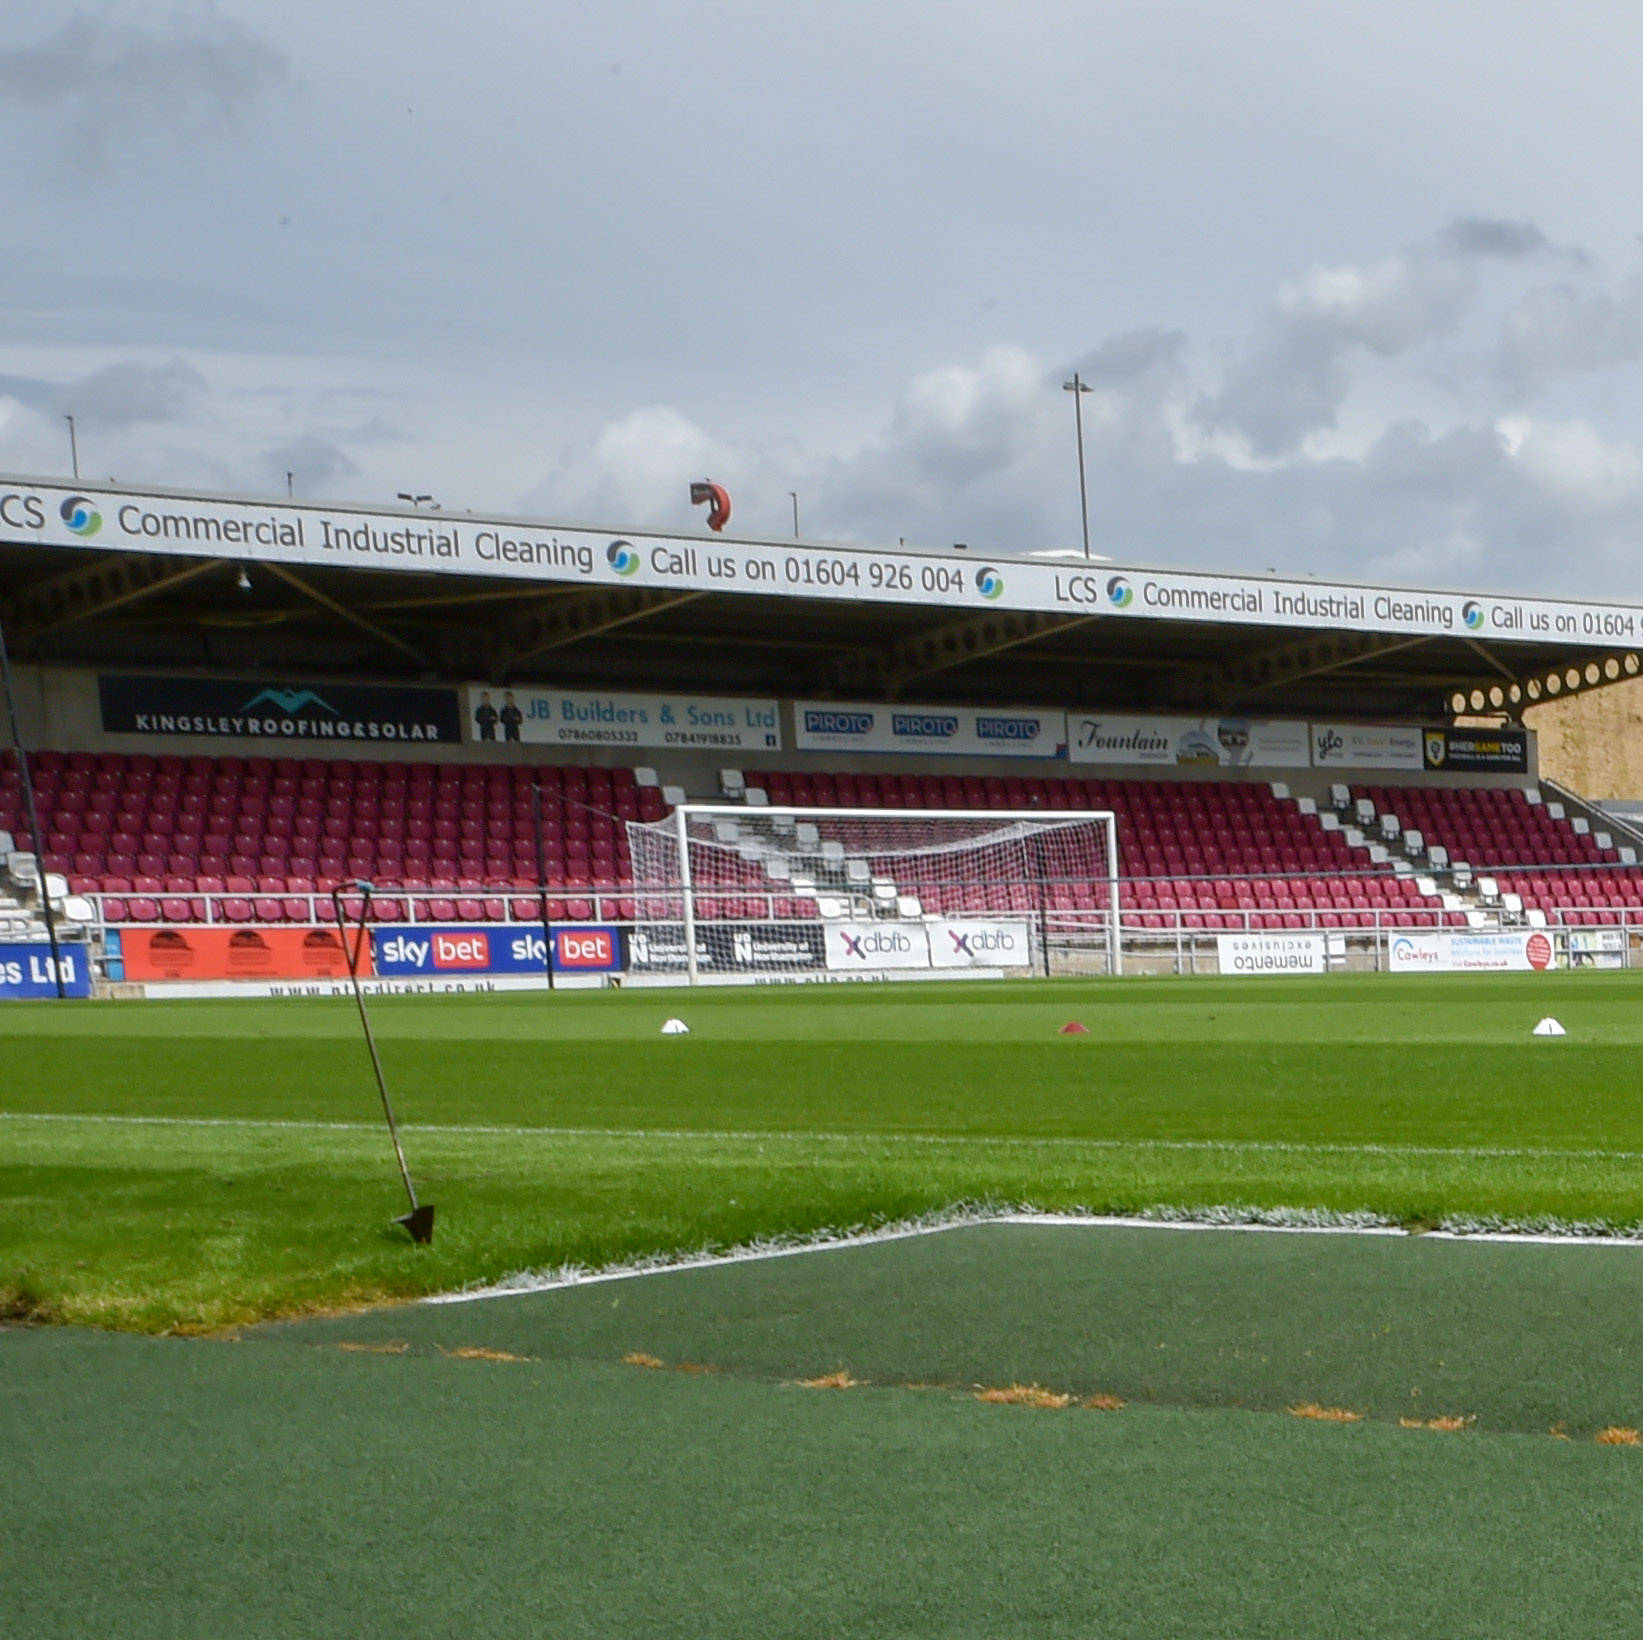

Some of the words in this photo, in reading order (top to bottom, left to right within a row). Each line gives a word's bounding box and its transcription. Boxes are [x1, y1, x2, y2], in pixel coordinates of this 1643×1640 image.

[118, 505, 305, 547] Commercial
[320, 521, 460, 558] Industrial
[475, 532, 593, 574] Cleaning
[651, 547, 698, 576] Call
[708, 556, 736, 579] us
[745, 558, 776, 581] on
[785, 557, 861, 586] 01604
[869, 563, 913, 590] 926
[921, 566, 965, 594] 004
[1054, 575, 1098, 603] LCS
[1143, 582, 1263, 613] Commercial
[1273, 590, 1365, 619] Industrial
[1374, 597, 1453, 627] Cleaning
[1491, 606, 1523, 630] Call
[1529, 612, 1550, 632] us
[1555, 613, 1577, 633] on
[1583, 612, 1636, 637] 01604
[527, 699, 550, 719] JB
[562, 700, 649, 724] Builders
[660, 705, 676, 725] &
[688, 705, 735, 726] Sons
[746, 707, 776, 728] Ltd
[1078, 720, 1169, 750] Fountain
[383, 935, 429, 967] sky
[439, 936, 485, 961] bet
[512, 935, 555, 967] sky
[564, 936, 607, 959] bet
